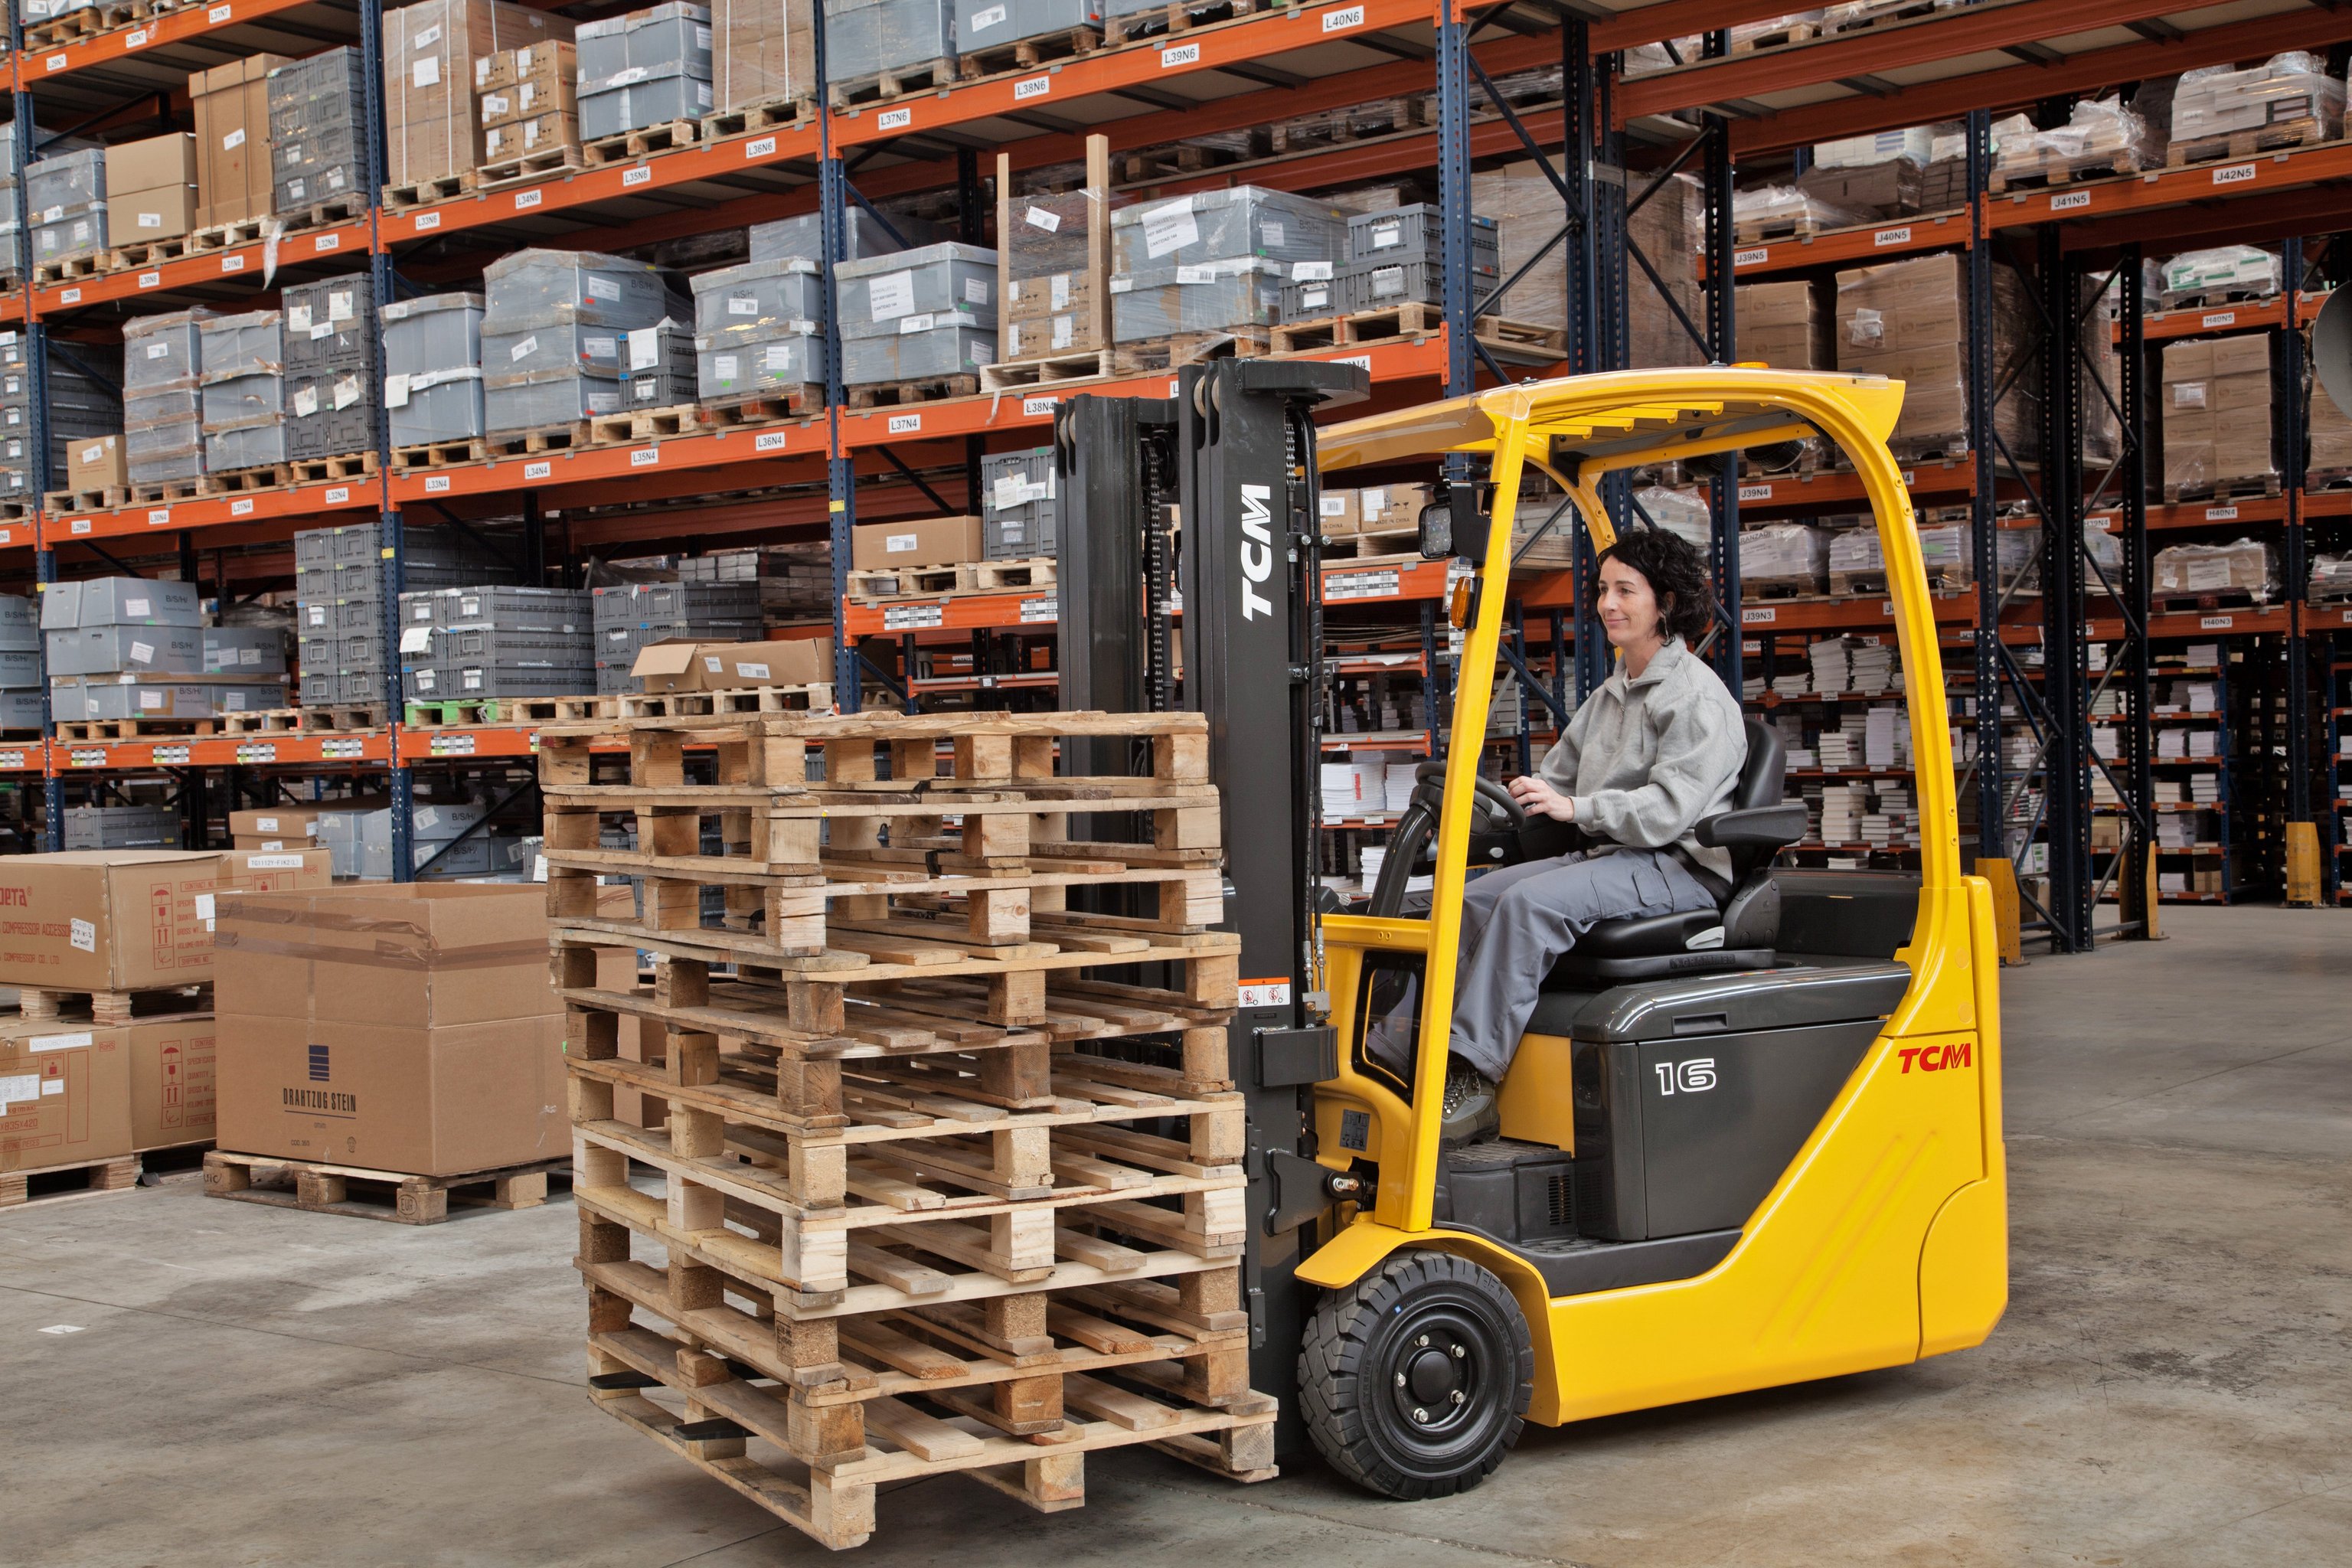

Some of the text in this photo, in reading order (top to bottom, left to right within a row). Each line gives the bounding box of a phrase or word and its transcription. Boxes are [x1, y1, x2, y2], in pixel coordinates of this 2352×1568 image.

[211, 8, 229, 21] L31N7
[1326, 11, 1359, 28] L40N6
[127, 32, 145, 45] L30N7
[1165, 48, 1195, 64] L39N6
[1018, 80, 1046, 96] L38N6
[880, 111, 906, 126] L37N6
[748, 142, 773, 155] L36N6
[626, 170, 648, 184] L35N6
[2217, 169, 2252, 181] J42N5
[518, 194, 539, 207] L34N6
[2055, 194, 2086, 207] J41N5
[417, 214, 437, 227] L33N6
[1878, 231, 1906, 243] J40N5
[317, 237, 336, 250] L32N6
[1737, 252, 1764, 263] J39N5
[223, 258, 241, 270] L31N6
[2206, 315, 2233, 324] H40N5
[1026, 401, 1055, 413] L38N4
[891, 418, 917, 430] L37N4
[758, 436, 782, 448] L36N4
[632, 451, 655, 463] L35N4
[527, 466, 548, 477] L34N4
[427, 480, 447, 490] L33N4
[327, 490, 346, 501] L32N4
[1742, 488, 1768, 498] J39N4
[233, 502, 250, 513] L31N4
[2209, 508, 2235, 518] H40N4
[150, 514, 166, 523] L30N4
[73, 523, 89, 532] L29N4
[1739, 531, 1772, 544] RANZADI
[1240, 484, 1272, 622] TCM
[1745, 612, 1772, 621] J39N3
[2204, 618, 2231, 626] H40N3
[452, 813, 475, 822] B/S/H/
[453, 846, 477, 854] B/S/H/
[2, 921, 40, 936] COMPRESSOR
[177, 927, 192, 936] GROSS
[4, 952, 35, 963] COMPRESSOR
[181, 956, 201, 965] SHIPPING
[1897, 1043, 1971, 1074] TCM
[187, 1070, 209, 1080] QUANTITY
[1655, 1057, 1717, 1096] 16
[188, 1086, 202, 1094] GROSS
[283, 1087, 356, 1112] DRAHTZUG STEIN
[8, 1104, 37, 1115] kg(max)
[400, 1197, 413, 1212] EUR
